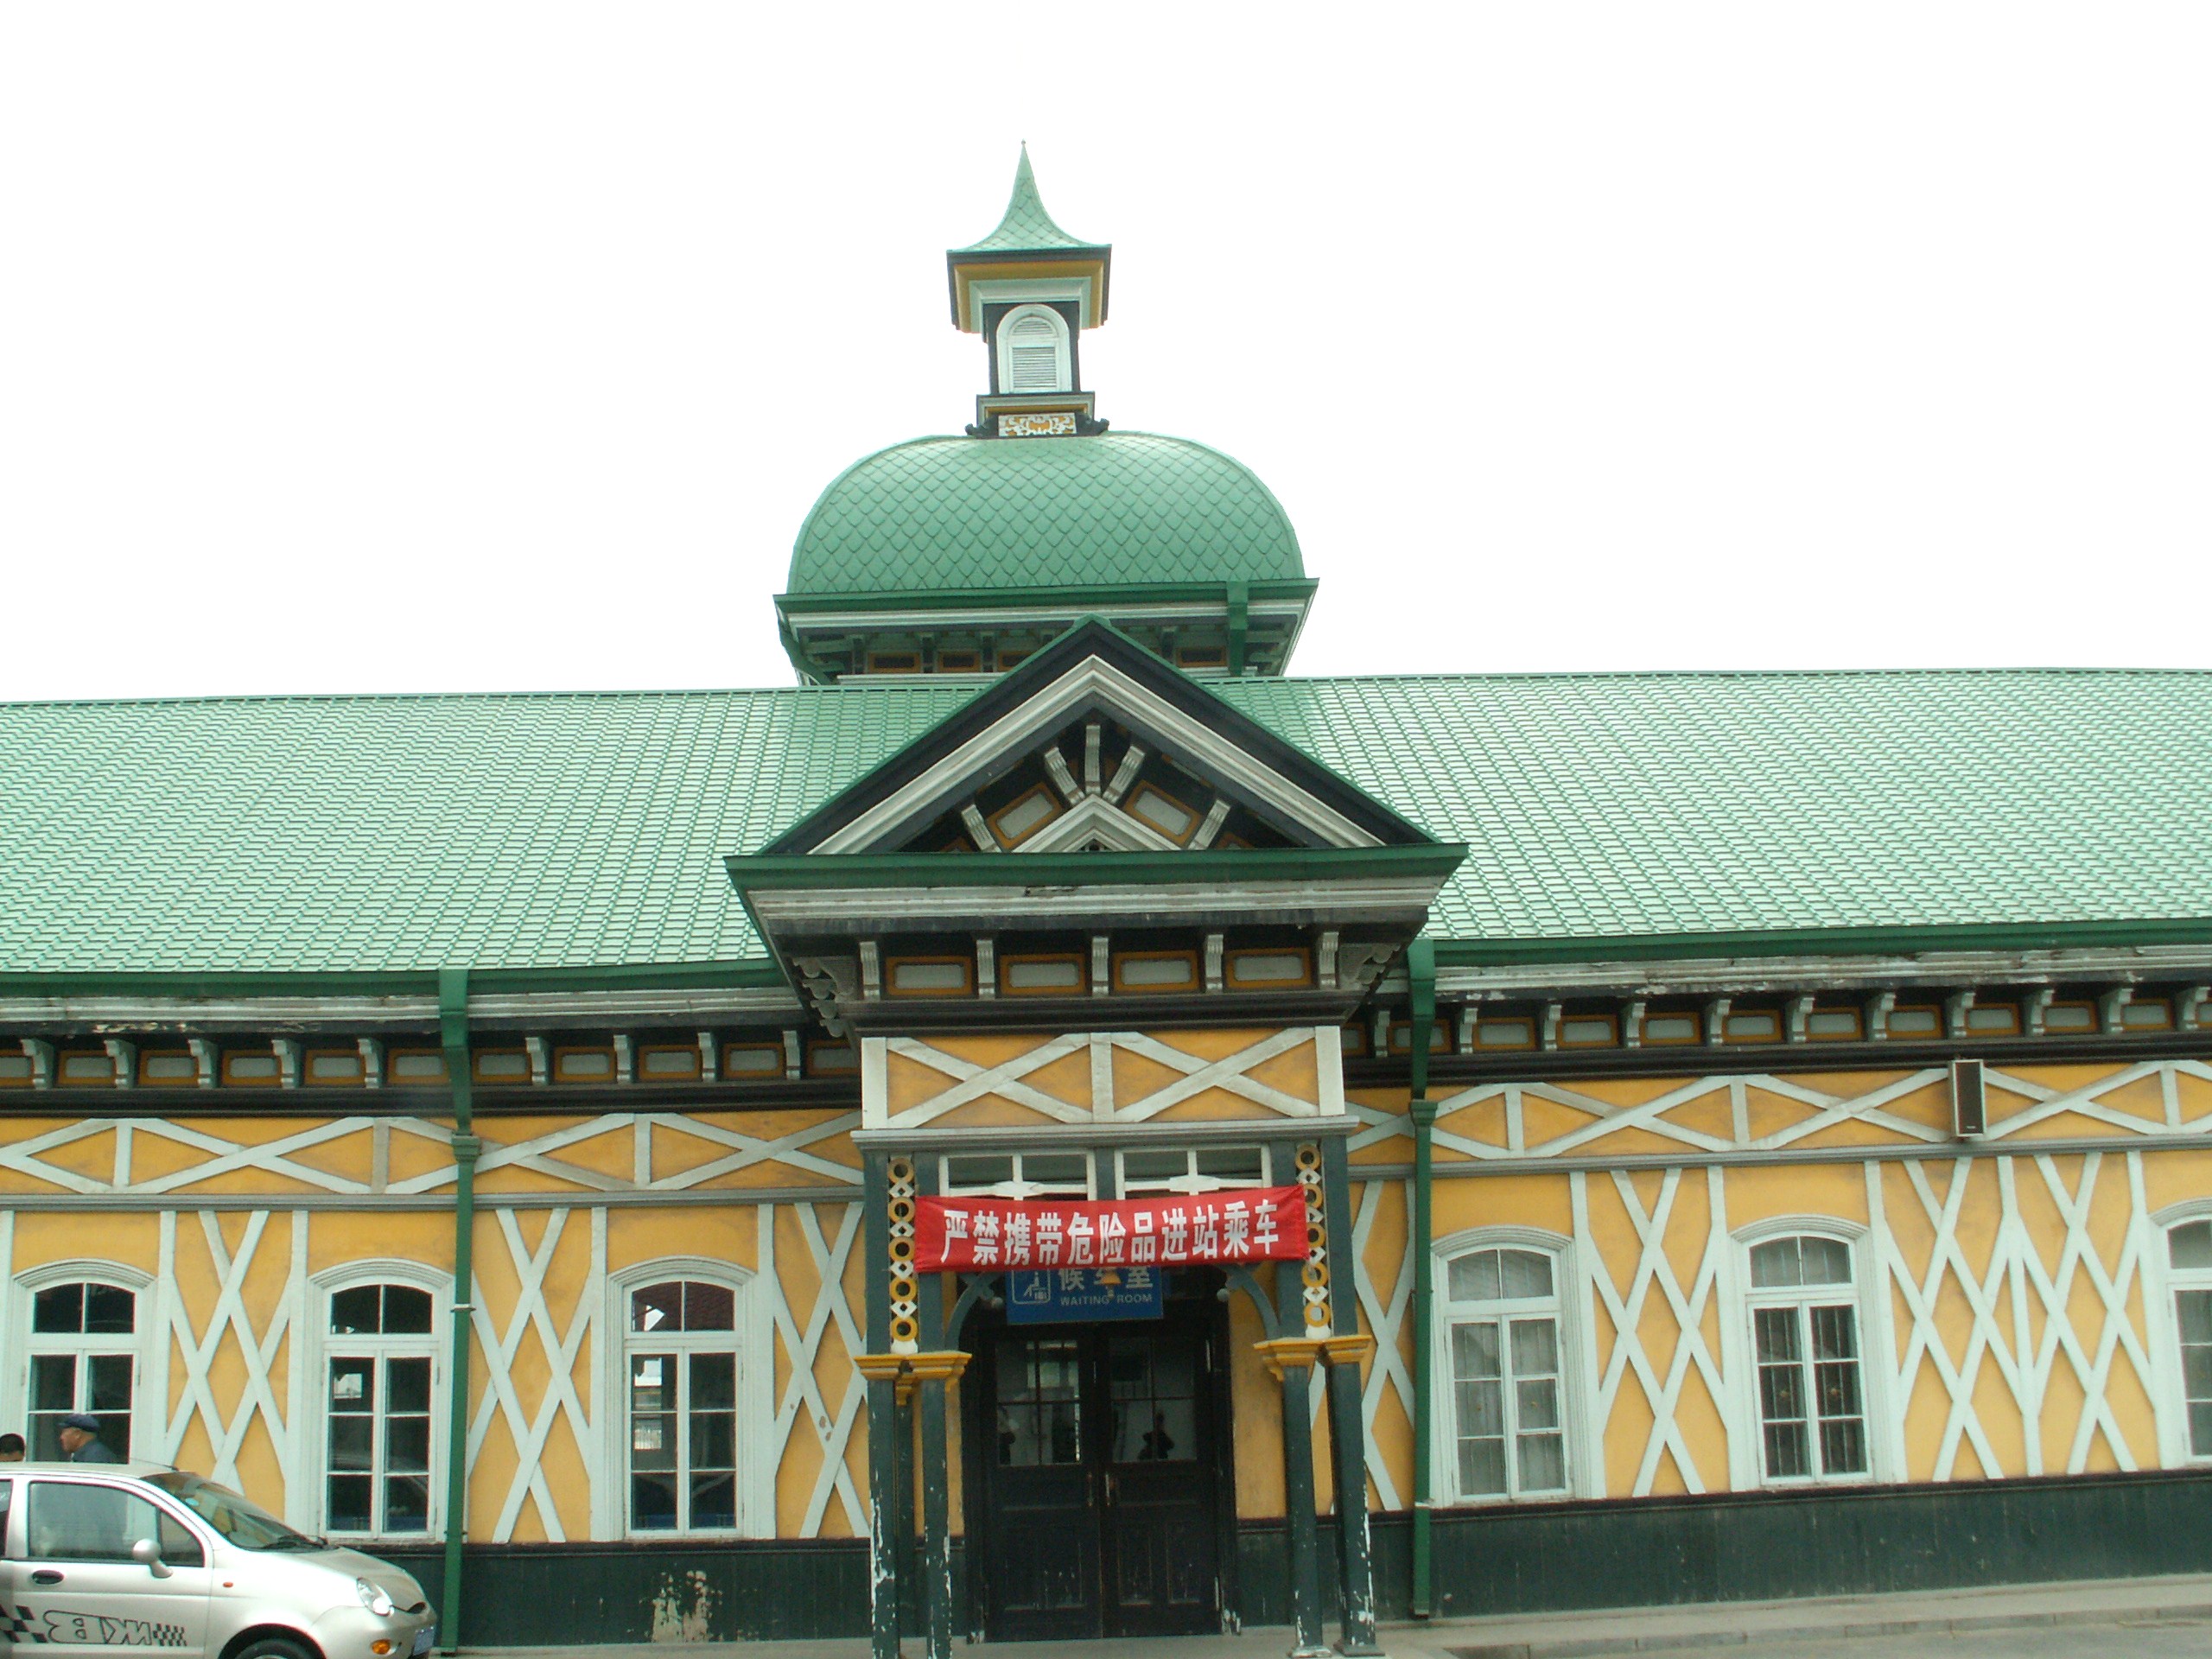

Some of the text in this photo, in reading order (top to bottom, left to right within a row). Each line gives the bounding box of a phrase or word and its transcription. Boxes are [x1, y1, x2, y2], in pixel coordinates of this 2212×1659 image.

[940, 1198, 1279, 1266] 严禁携带危险品进站乘车
[1059, 1293, 1153, 1306] WAITING ROOM
